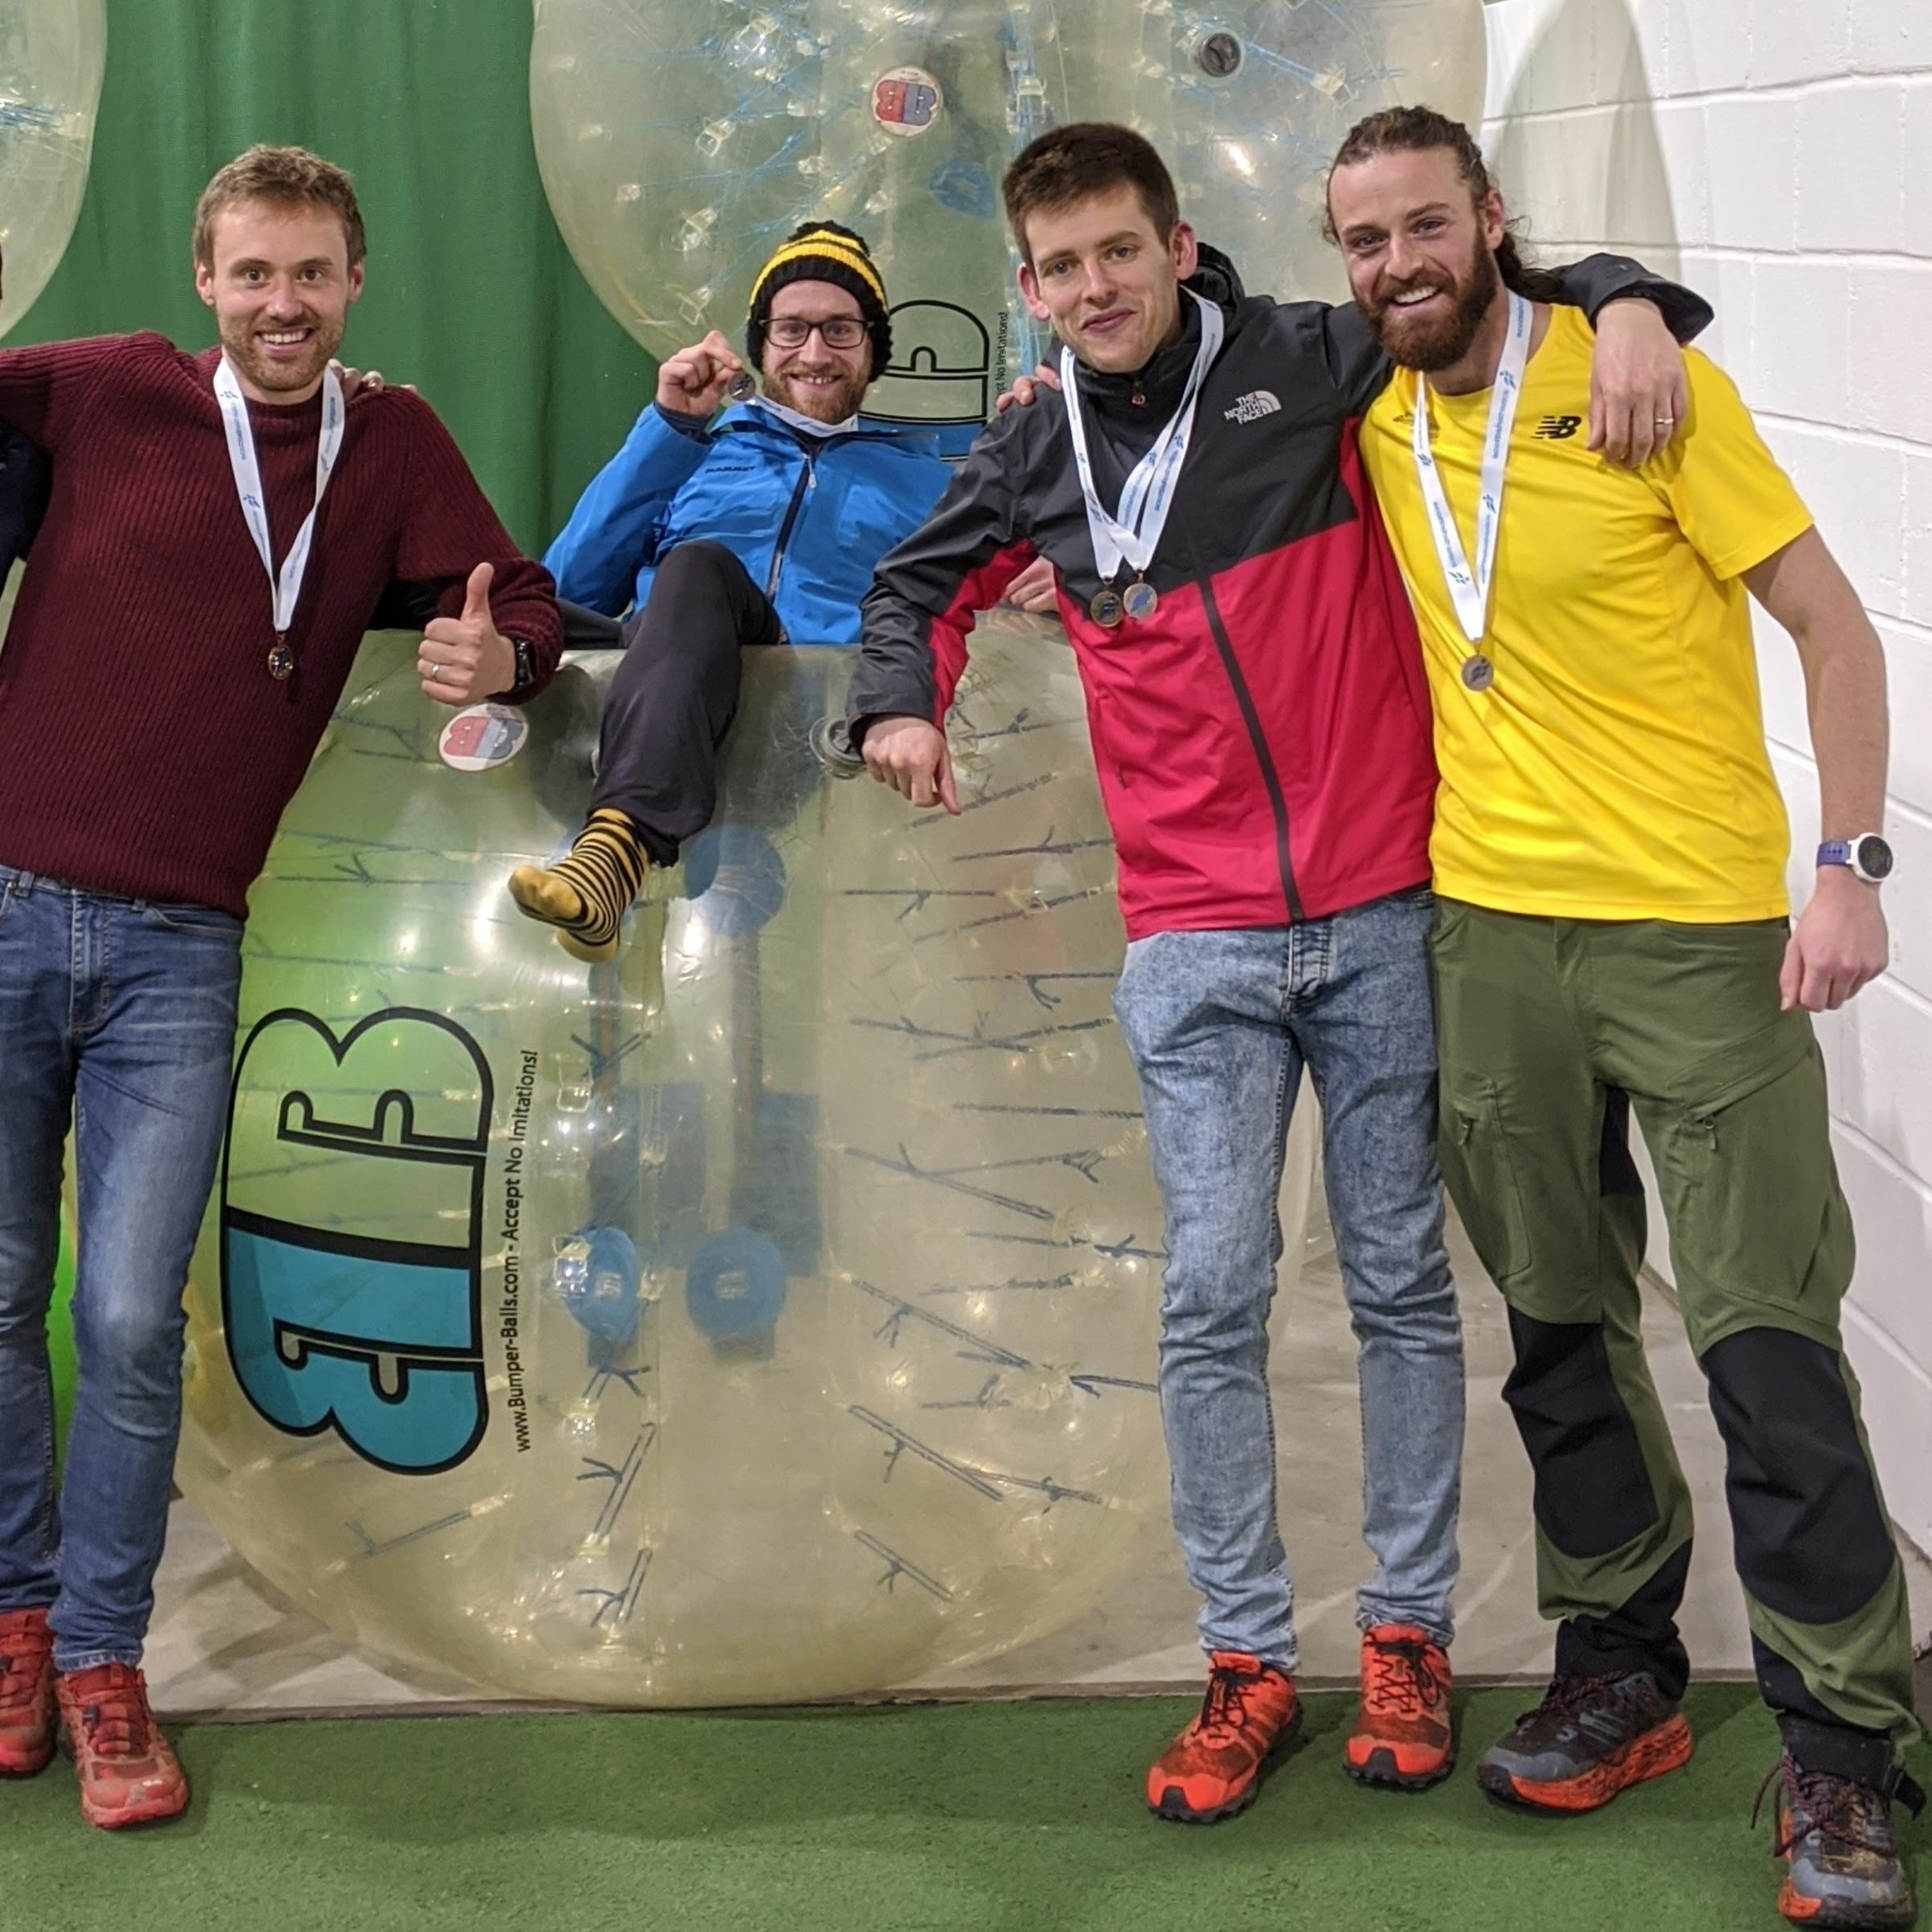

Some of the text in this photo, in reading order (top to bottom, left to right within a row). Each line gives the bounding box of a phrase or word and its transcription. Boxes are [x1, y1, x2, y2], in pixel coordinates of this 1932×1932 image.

[508, 1050, 538, 1141] Imitations!
[504, 1147, 523, 1173] No
[501, 1179, 524, 1241] Accept
[499, 1257, 531, 1452] www.Bumper-Balls.com
